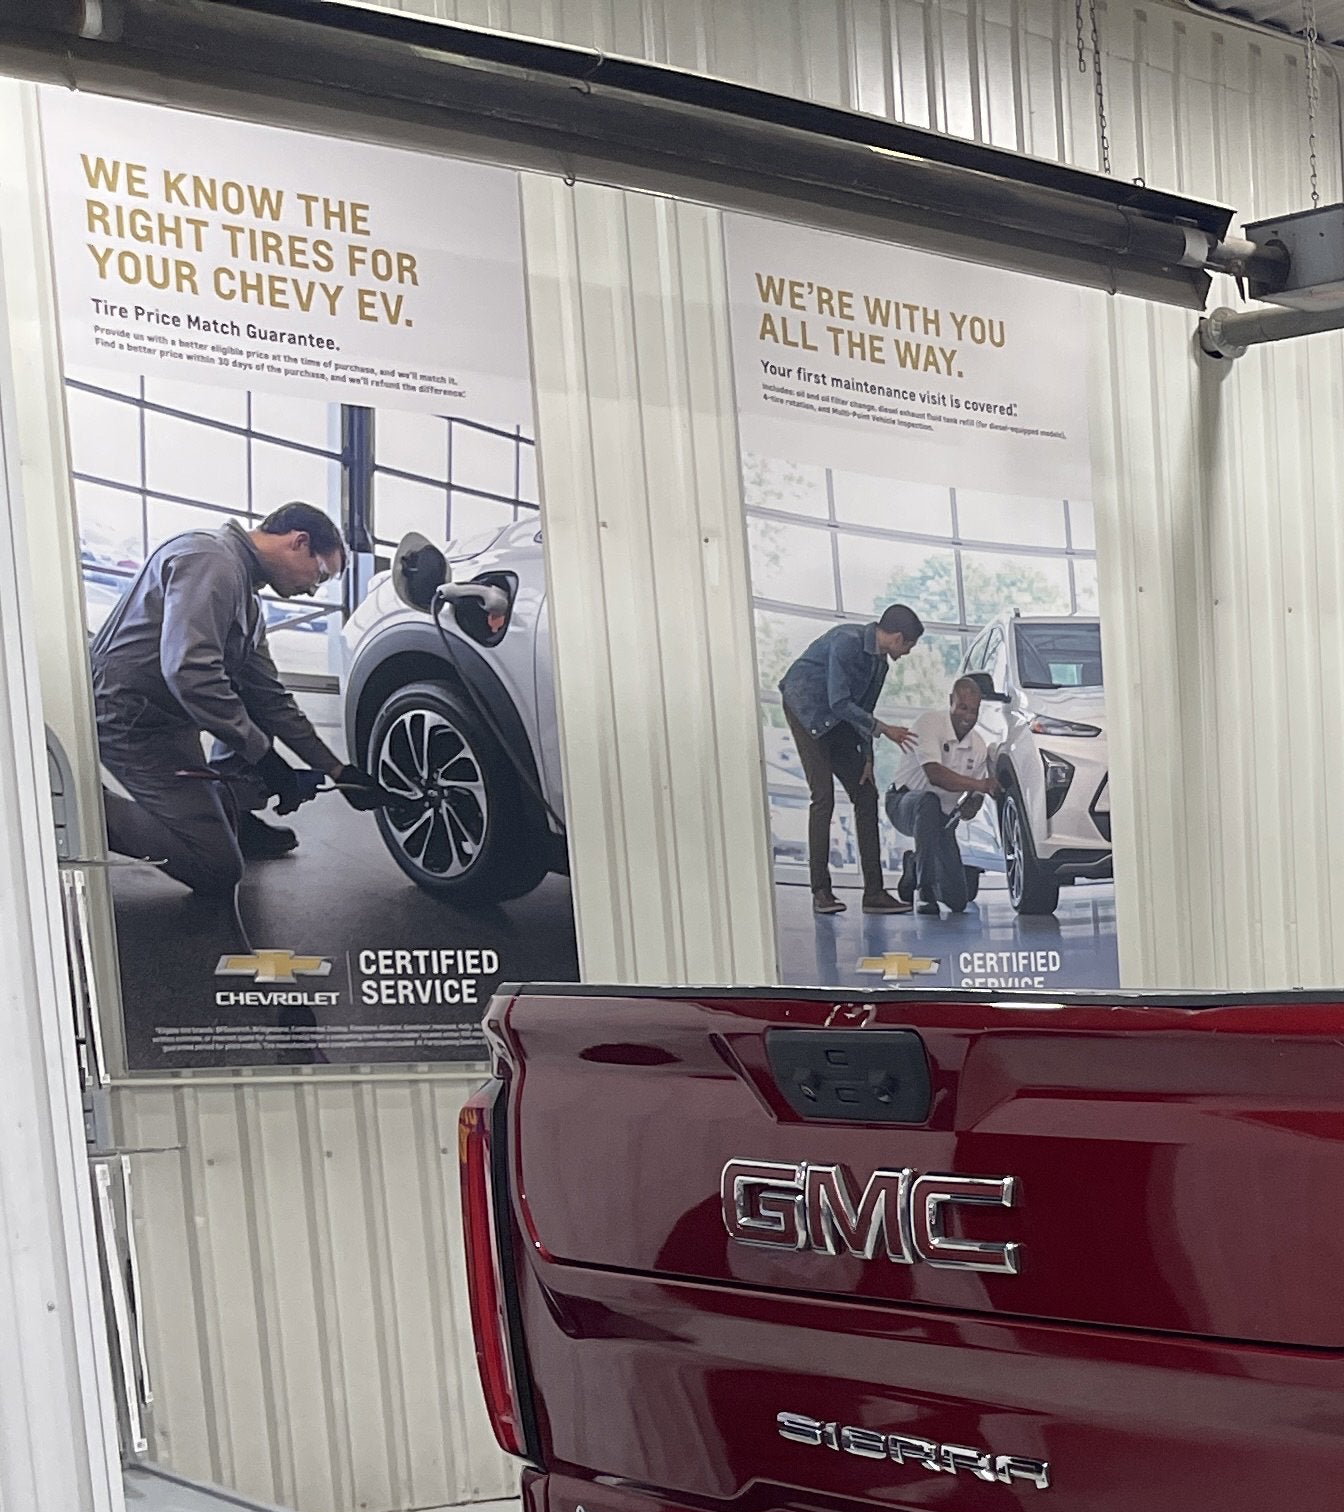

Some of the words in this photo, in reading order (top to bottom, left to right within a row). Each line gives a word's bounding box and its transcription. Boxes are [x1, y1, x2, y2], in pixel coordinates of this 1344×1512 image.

[80, 153, 149, 198] WE
[164, 170, 284, 221] KNOW
[297, 193, 371, 236] THE
[87, 199, 209, 252] RIGHT
[222, 224, 334, 272] TIRES
[348, 244, 418, 286] FOR
[88, 244, 198, 294] YOUR
[214, 266, 344, 316] CHEVY
[358, 288, 414, 327] EV.
[91, 298, 128, 318] Tire
[135, 305, 181, 327] Price
[187, 315, 240, 337] Match
[246, 323, 340, 351] Guarantee.
[759, 313, 818, 351] ALL
[827, 326, 886, 365] THE
[894, 338, 965, 378] WAY.
[863, 295, 940, 338] WITH
[949, 311, 1006, 348] YOU
[94, 325, 130, 339] Provide
[134, 333, 144, 341] us
[147, 335, 168, 345] with
[179, 338, 207, 351] better
[211, 344, 243, 356] eligible
[246, 350, 269, 360] price
[283, 354, 298, 364] the
[301, 357, 320, 368] time
[323, 360, 332, 368] of
[334, 363, 377, 376] purchase,
[380, 368, 395, 377] and
[420, 372, 446, 384] match
[95, 337, 115, 349] Find
[127, 343, 156, 355] better
[160, 348, 183, 360] price
[186, 352, 215, 364] within
[218, 356, 229, 366] 30
[232, 359, 253, 371] days
[267, 364, 281, 374] the
[284, 366, 328, 381] purchase,
[330, 374, 346, 383] and
[371, 379, 400, 390] refund
[402, 383, 416, 392] the
[761, 359, 792, 378] Your
[797, 367, 827, 386] first
[831, 376, 916, 401] maintenance
[919, 391, 946, 407] visit
[950, 394, 960, 409] is
[358, 949, 499, 976] CERTIFIED
[959, 951, 1060, 973] CERTIFIED
[215, 991, 340, 1006] CHEVROLET
[361, 979, 478, 1005] SERVICE
[720, 1157, 1023, 1275] GMC
[776, 1410, 1052, 1491] SIERRA
